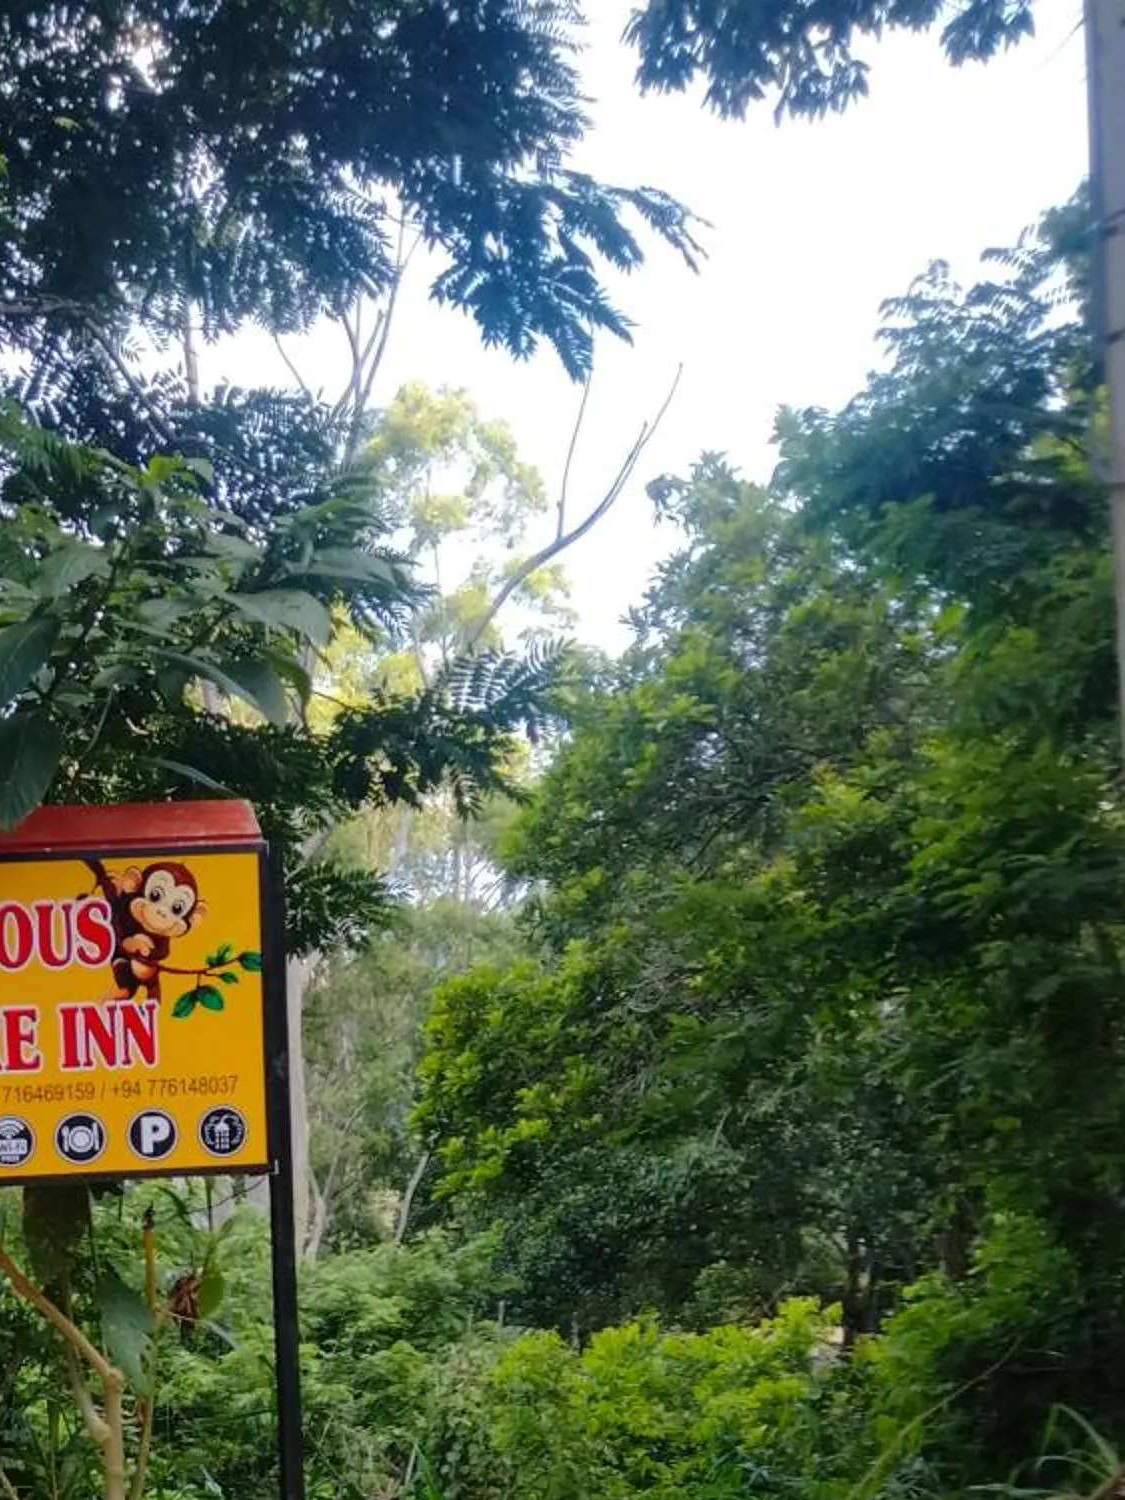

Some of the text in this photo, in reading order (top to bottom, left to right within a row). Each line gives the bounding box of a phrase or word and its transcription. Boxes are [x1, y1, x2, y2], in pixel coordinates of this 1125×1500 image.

[60, 1000, 159, 1069] INN
[4, 1082, 96, 1104] 716469159
[112, 1079, 140, 1099] +94
[148, 1076, 238, 1097] 776148037
[140, 1116, 170, 1154] P
